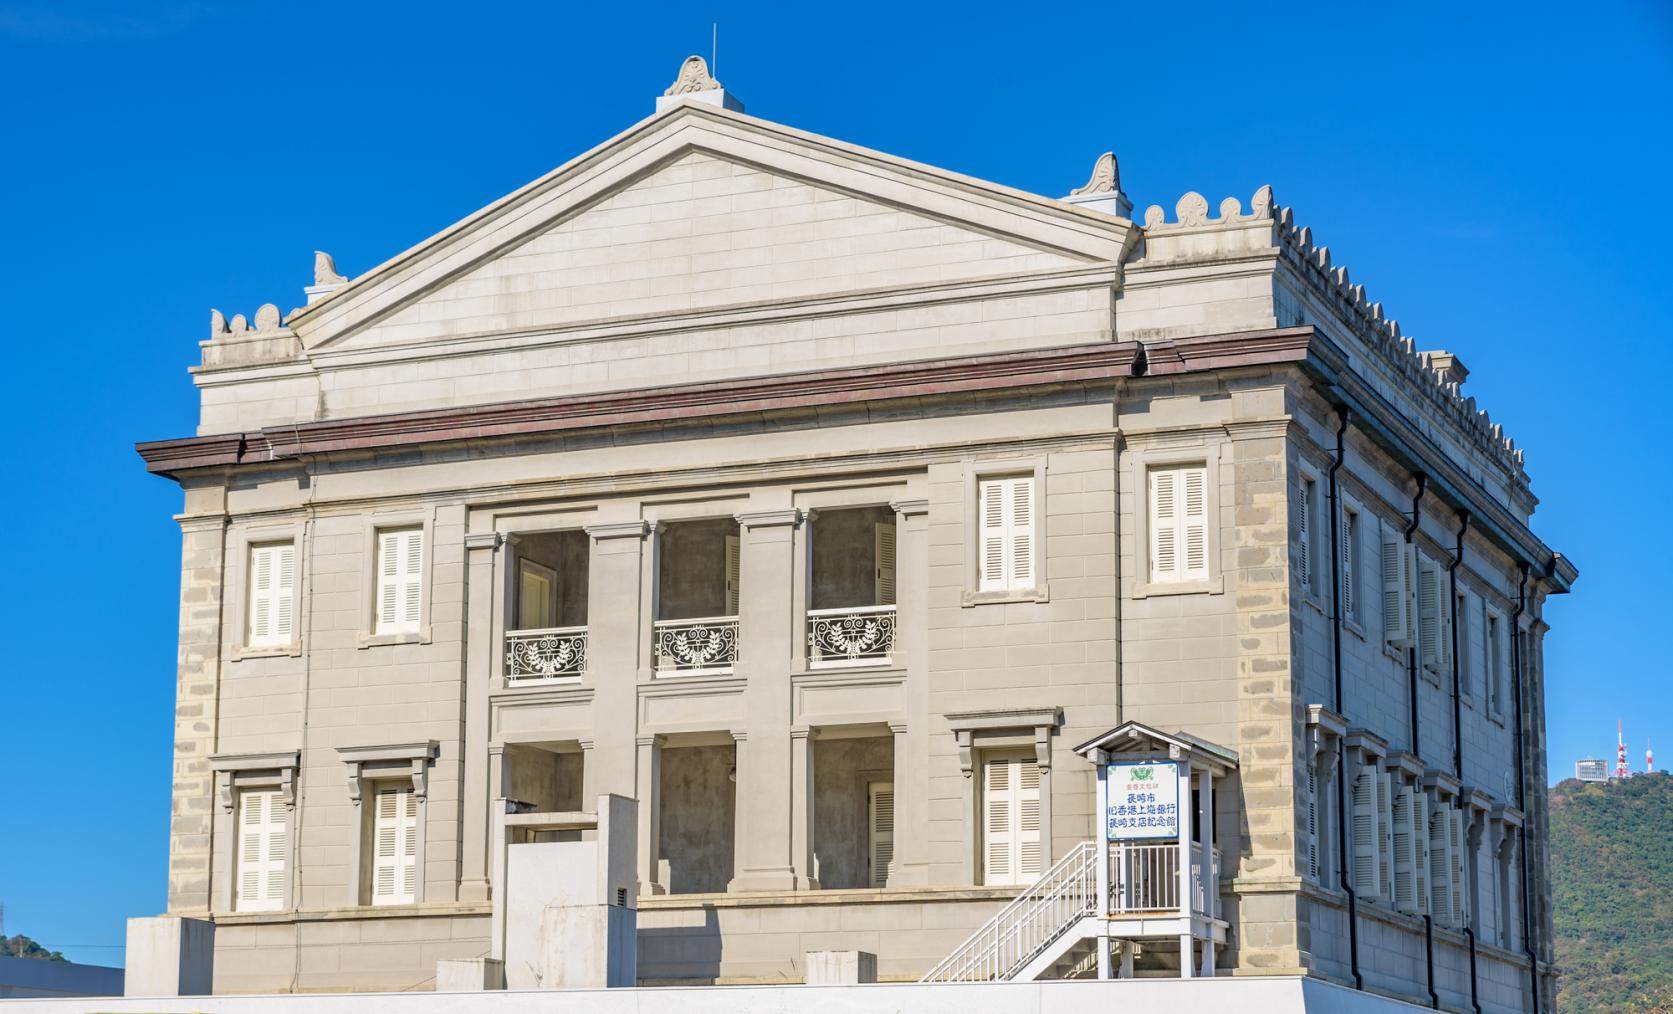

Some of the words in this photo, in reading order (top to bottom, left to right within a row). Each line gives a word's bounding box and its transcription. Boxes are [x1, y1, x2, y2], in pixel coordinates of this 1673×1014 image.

[1127, 793, 1156, 803] 長崎市
[1109, 804, 1176, 816] 旧香港上海銀行
[1109, 816, 1176, 828] 長崎支店記念館
